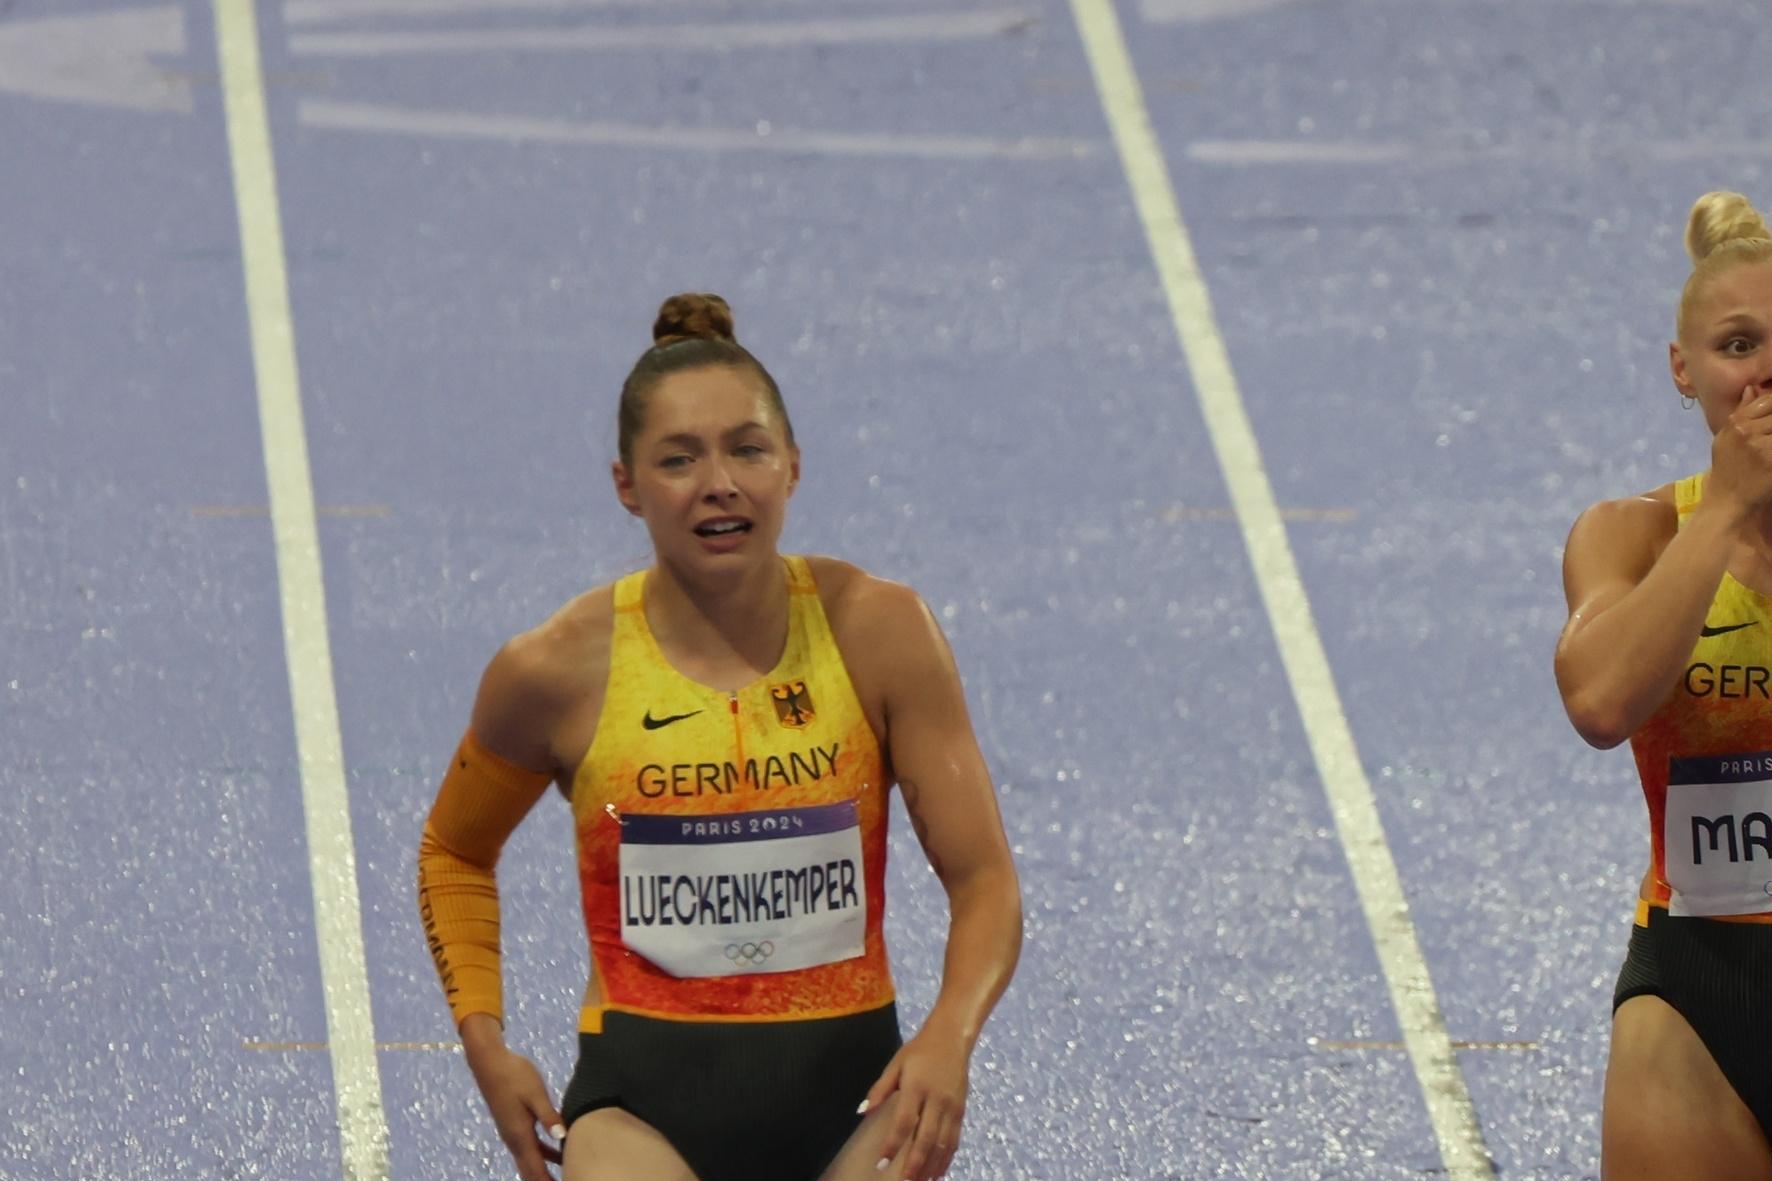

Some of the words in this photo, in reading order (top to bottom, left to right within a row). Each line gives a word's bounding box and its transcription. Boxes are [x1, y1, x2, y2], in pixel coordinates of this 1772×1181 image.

[637, 742, 840, 798] GERMANY
[681, 820, 742, 837] PARIS
[749, 815, 804, 834] 2024
[624, 858, 859, 927] LUECKENKEMPER
